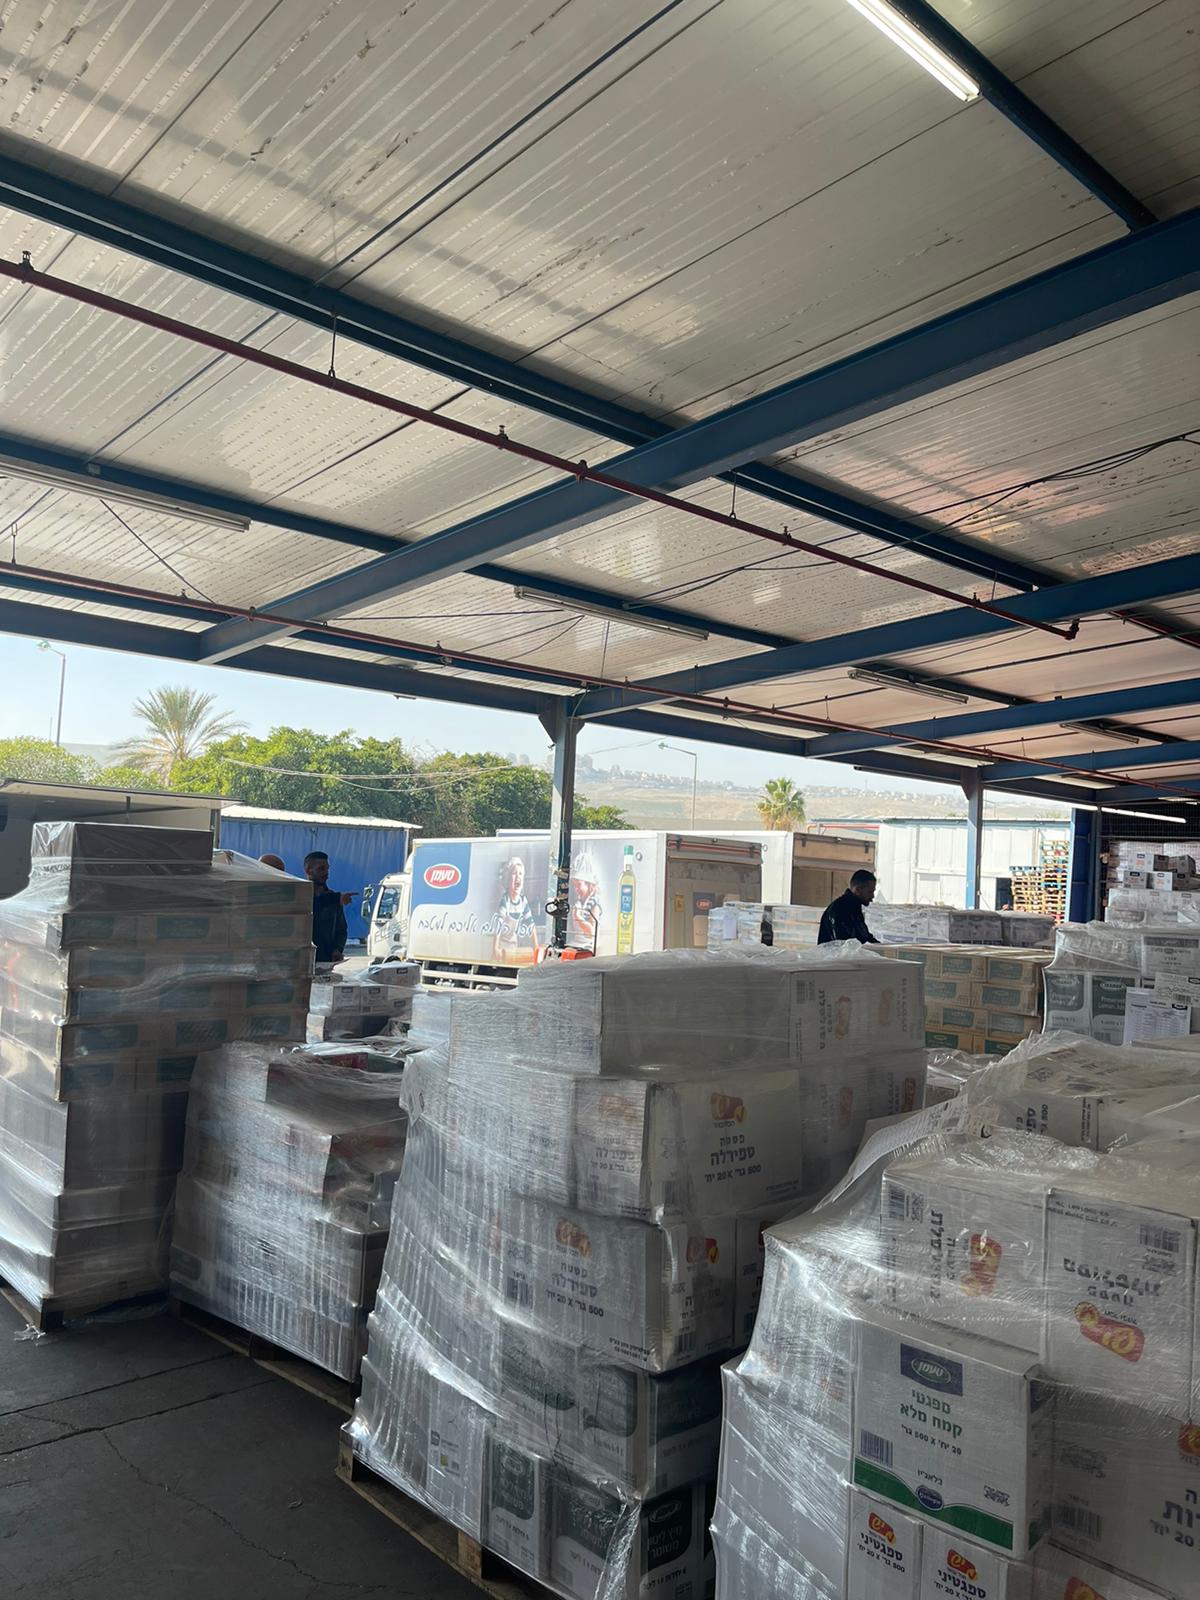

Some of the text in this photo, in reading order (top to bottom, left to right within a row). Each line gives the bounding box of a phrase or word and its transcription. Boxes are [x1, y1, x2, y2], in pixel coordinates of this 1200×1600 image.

[430, 869, 456, 884] טעמן
[417, 911, 449, 931] למטבח
[448, 912, 478, 933] אליכם
[720, 1134, 745, 1148] פסטה
[710, 1146, 756, 1166] ספירלה
[748, 1164, 762, 1175] 500
[560, 1261, 588, 1278] פסטה
[551, 1272, 598, 1298] ספירלה
[1087, 1286, 1134, 1307] פסטה
[588, 1305, 604, 1318] 500
[918, 1360, 945, 1378] טעמן
[911, 1388, 952, 1415] ספגטי
[900, 1403, 963, 1439] קמח מלא
[914, 1431, 929, 1442] 500
[951, 1445, 962, 1456] 20
[860, 1532, 903, 1561] ספגטיני
[1174, 1530, 1194, 1548] 20
[867, 1549, 875, 1557] 20
[892, 1562, 905, 1573] 500
[937, 1569, 986, 1599] ספגטיני
[945, 1586, 955, 1595] 20
